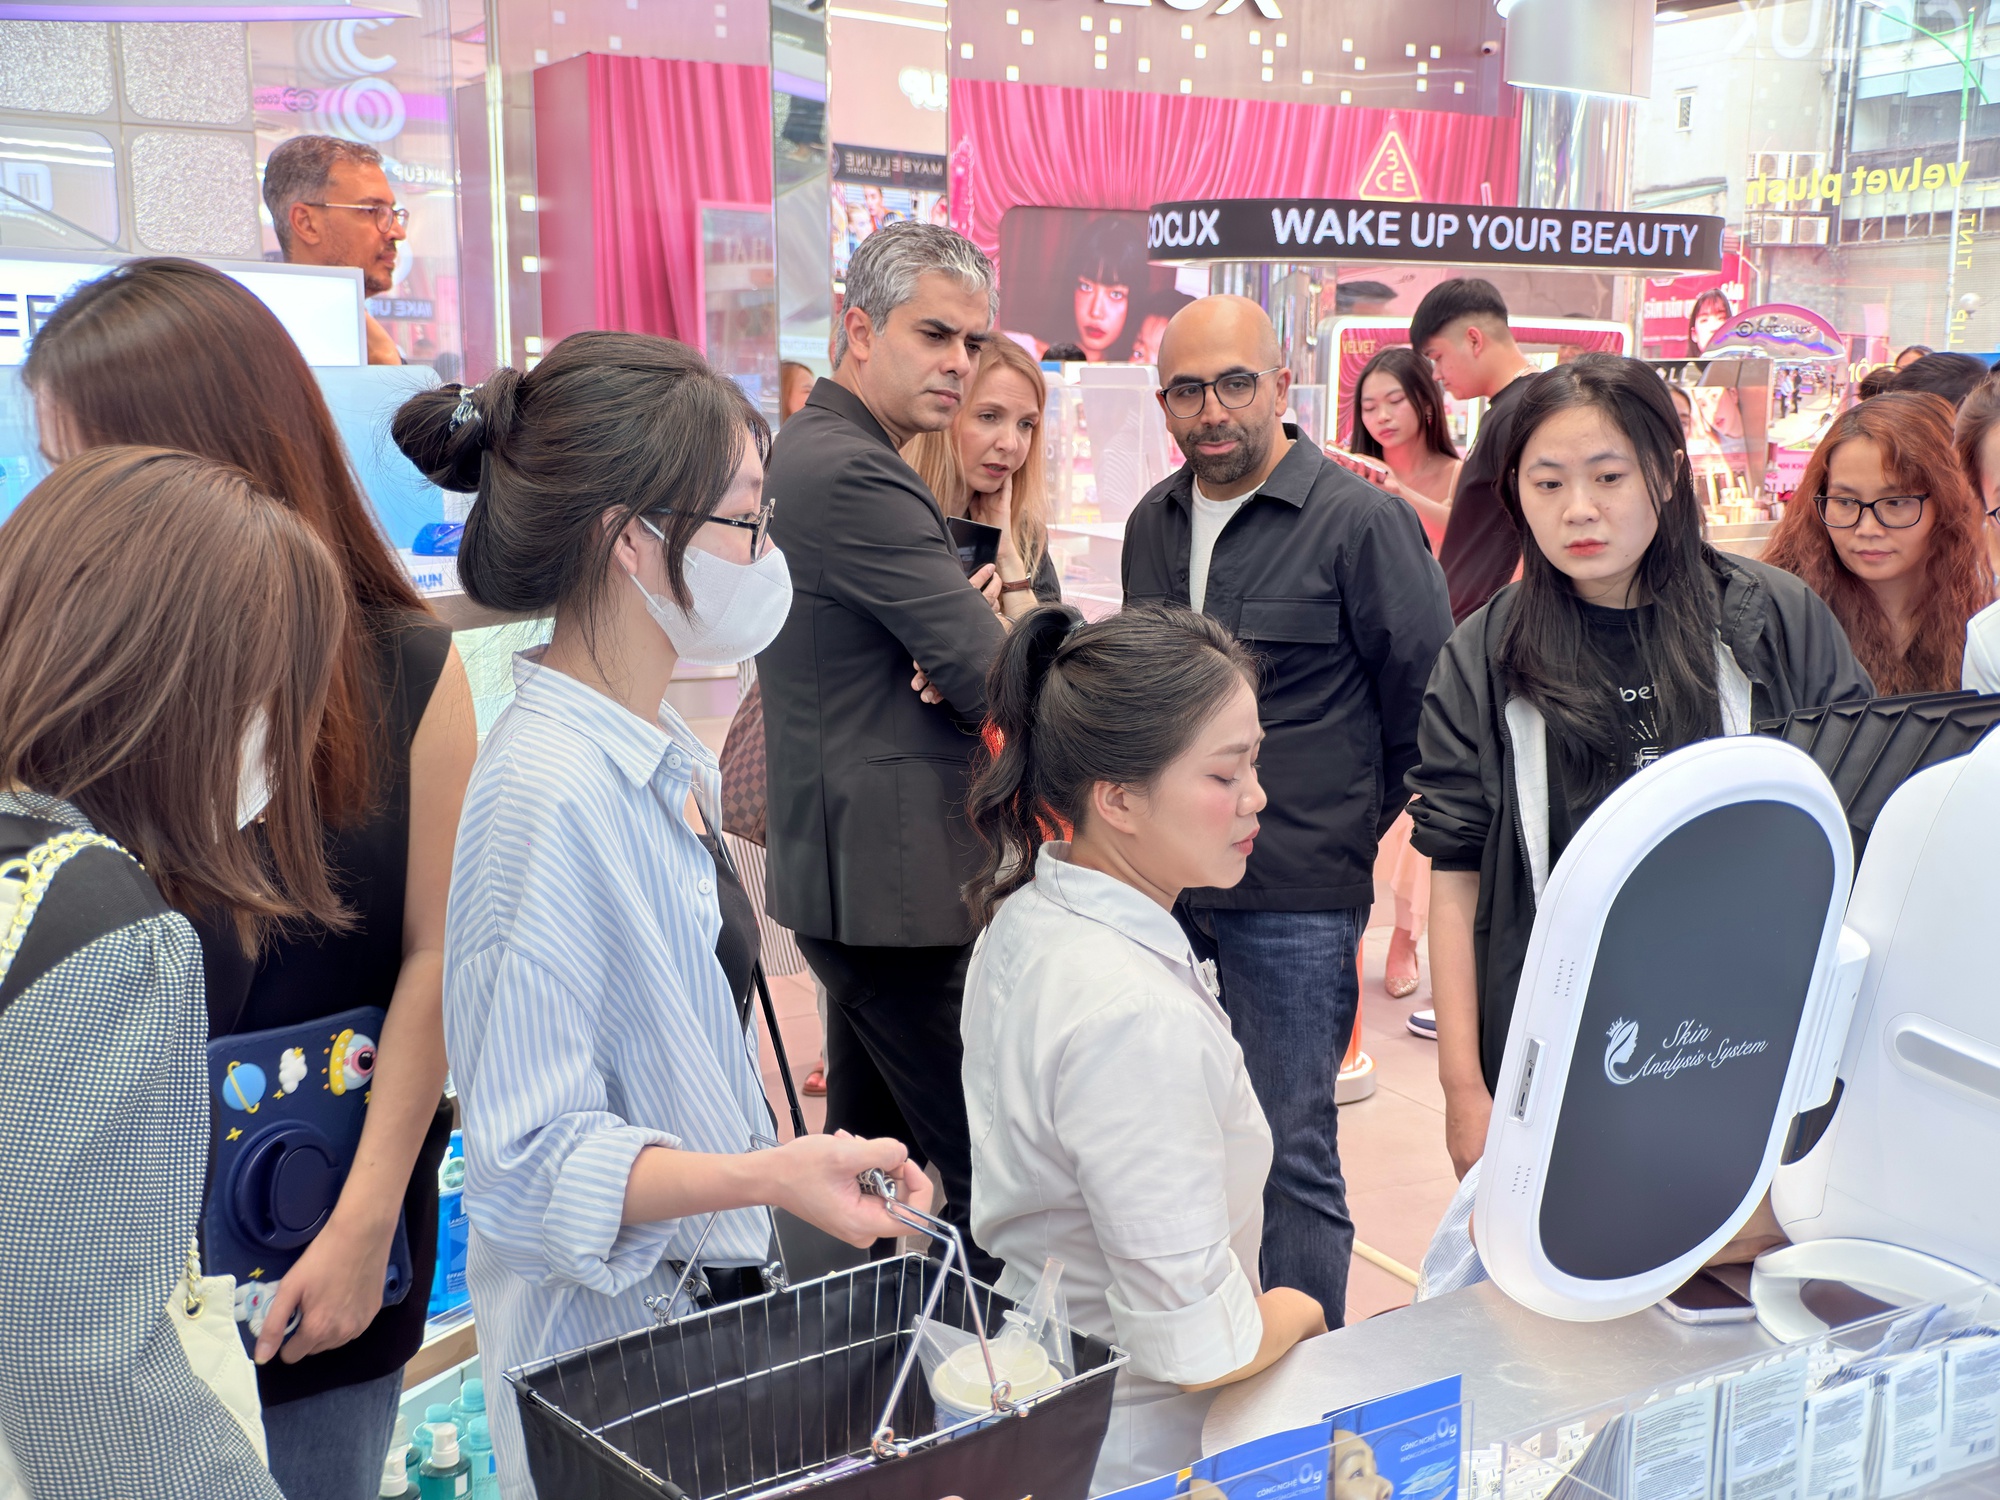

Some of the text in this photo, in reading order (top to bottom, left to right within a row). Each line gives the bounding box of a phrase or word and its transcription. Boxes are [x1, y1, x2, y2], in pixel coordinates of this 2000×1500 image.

[1272, 207, 1401, 246] WAKE
[1410, 211, 1459, 249] UP
[1467, 213, 1562, 253] YOUR
[1570, 219, 1699, 257] BEAUTY
[1662, 1018, 1713, 1049] Skin
[1629, 1037, 1769, 1080] Analysis System
